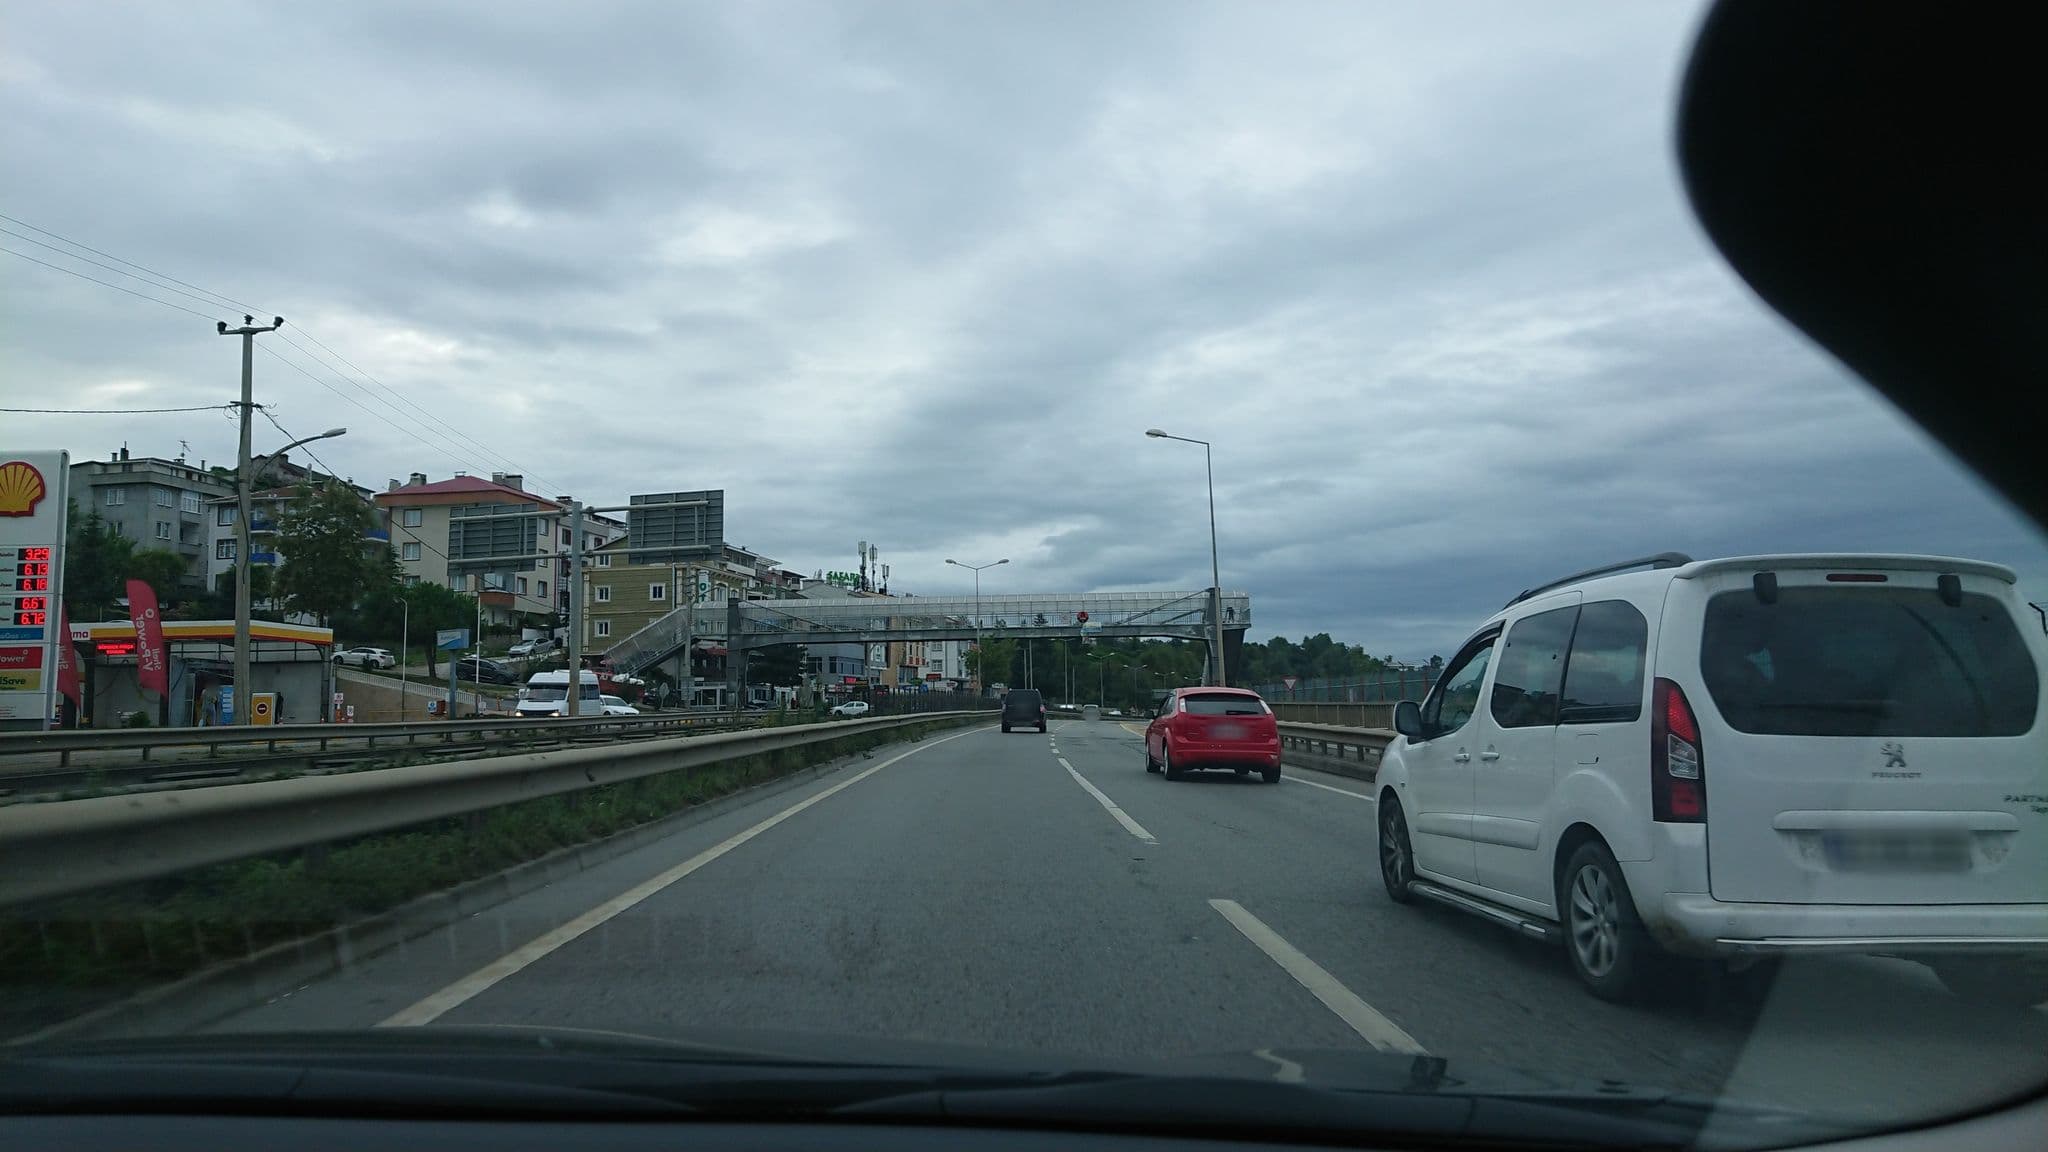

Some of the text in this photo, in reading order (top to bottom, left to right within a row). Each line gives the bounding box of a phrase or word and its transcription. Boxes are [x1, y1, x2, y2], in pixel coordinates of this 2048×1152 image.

[24, 563, 48, 576] 6.13
[23, 579, 48, 591] 6.18
[22, 597, 47, 610] 6.67
[21, 612, 45, 625] 6.72
[71, 630, 89, 639] ma
[0, 655, 25, 663] ower
